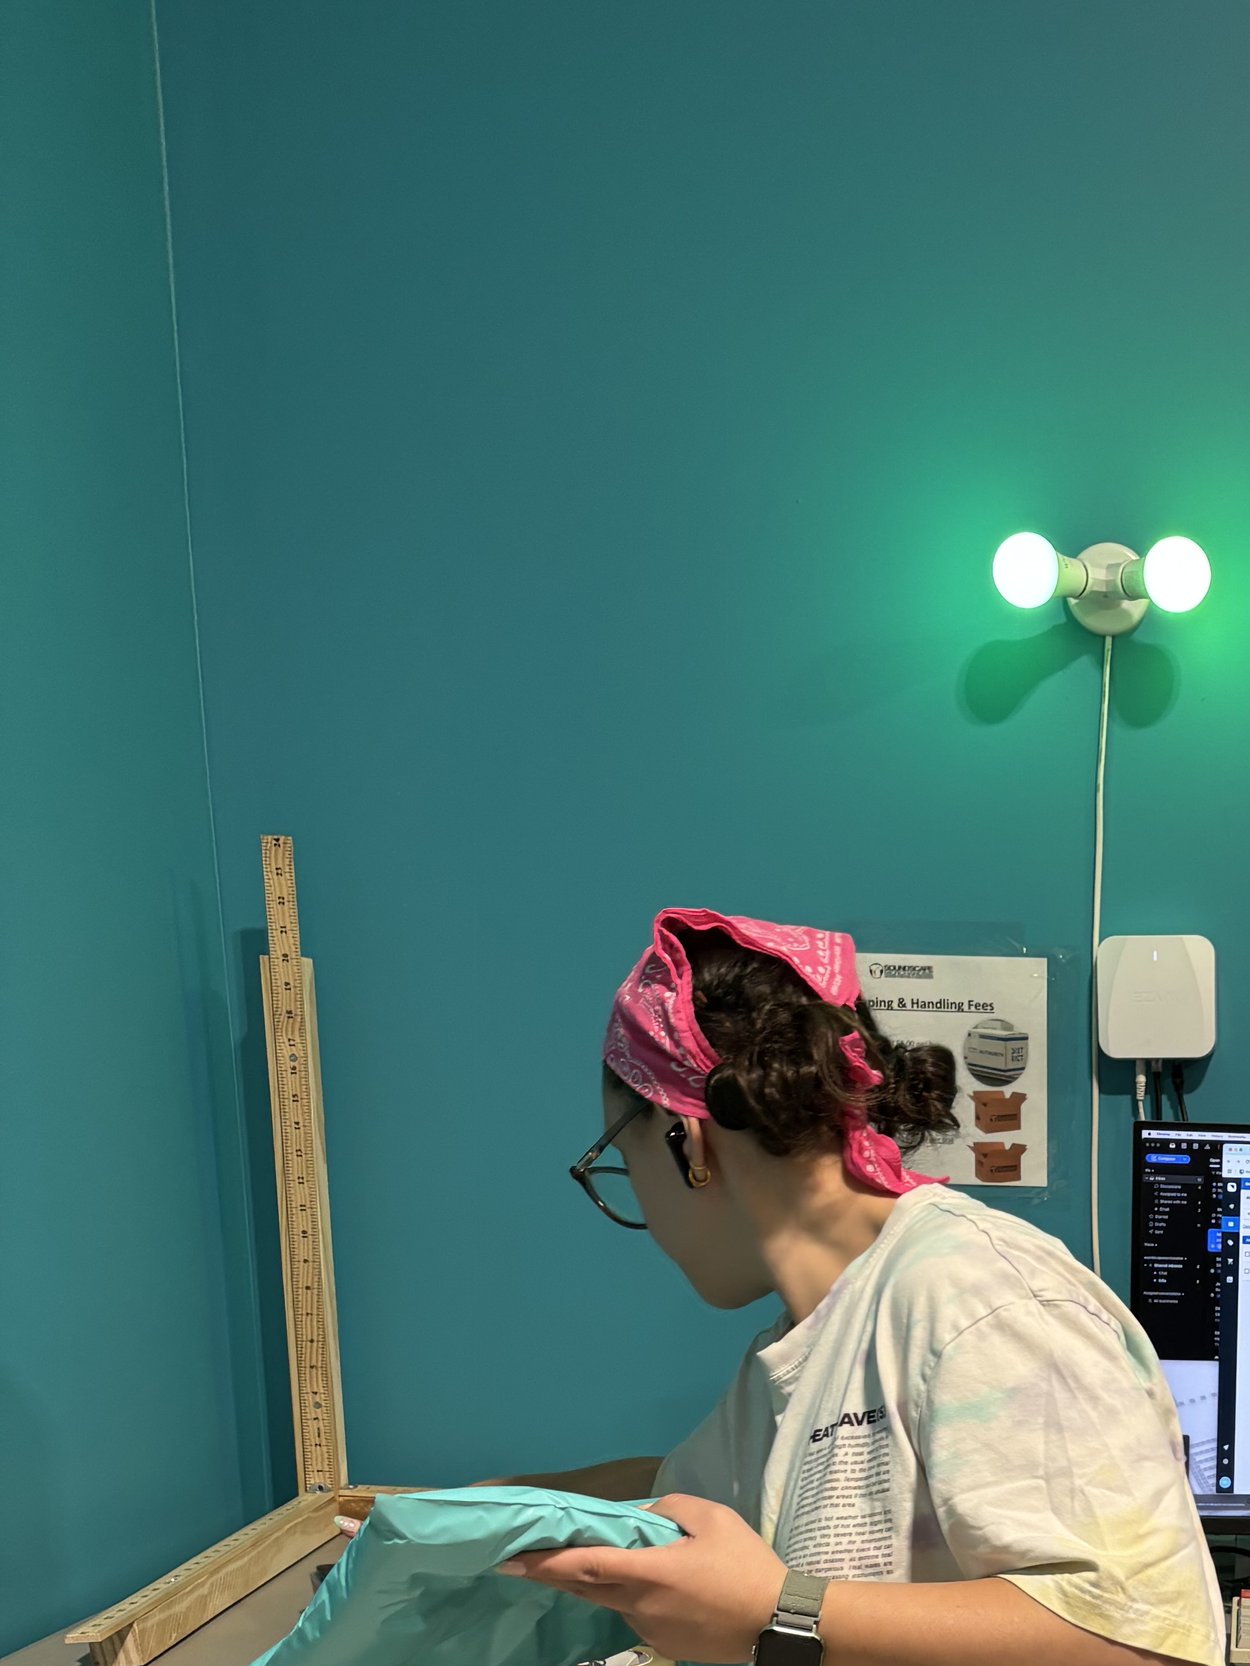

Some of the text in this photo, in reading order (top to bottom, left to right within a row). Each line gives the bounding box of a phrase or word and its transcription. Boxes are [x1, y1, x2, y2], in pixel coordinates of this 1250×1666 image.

[884, 964, 934, 973] SOUNDSCAPE
[897, 997, 907, 1008] &
[911, 998, 964, 1012] Handling
[967, 999, 995, 1011] Fees
